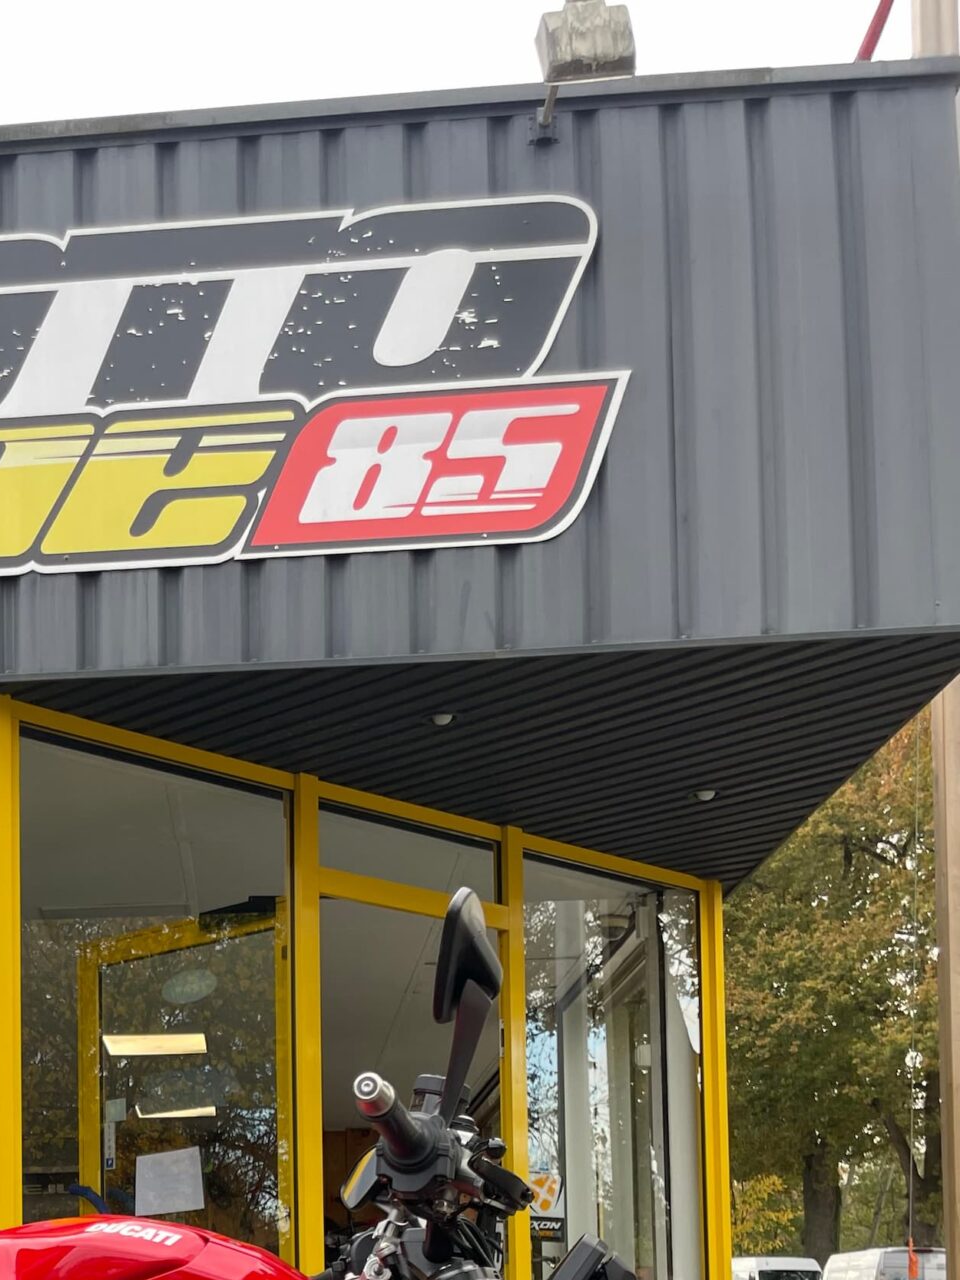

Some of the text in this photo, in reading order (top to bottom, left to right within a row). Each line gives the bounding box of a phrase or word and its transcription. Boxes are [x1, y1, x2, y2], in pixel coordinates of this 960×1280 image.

[296, 398, 582, 526] 85
[84, 1221, 183, 1247] DUCATI
[530, 1220, 561, 1231] XON
